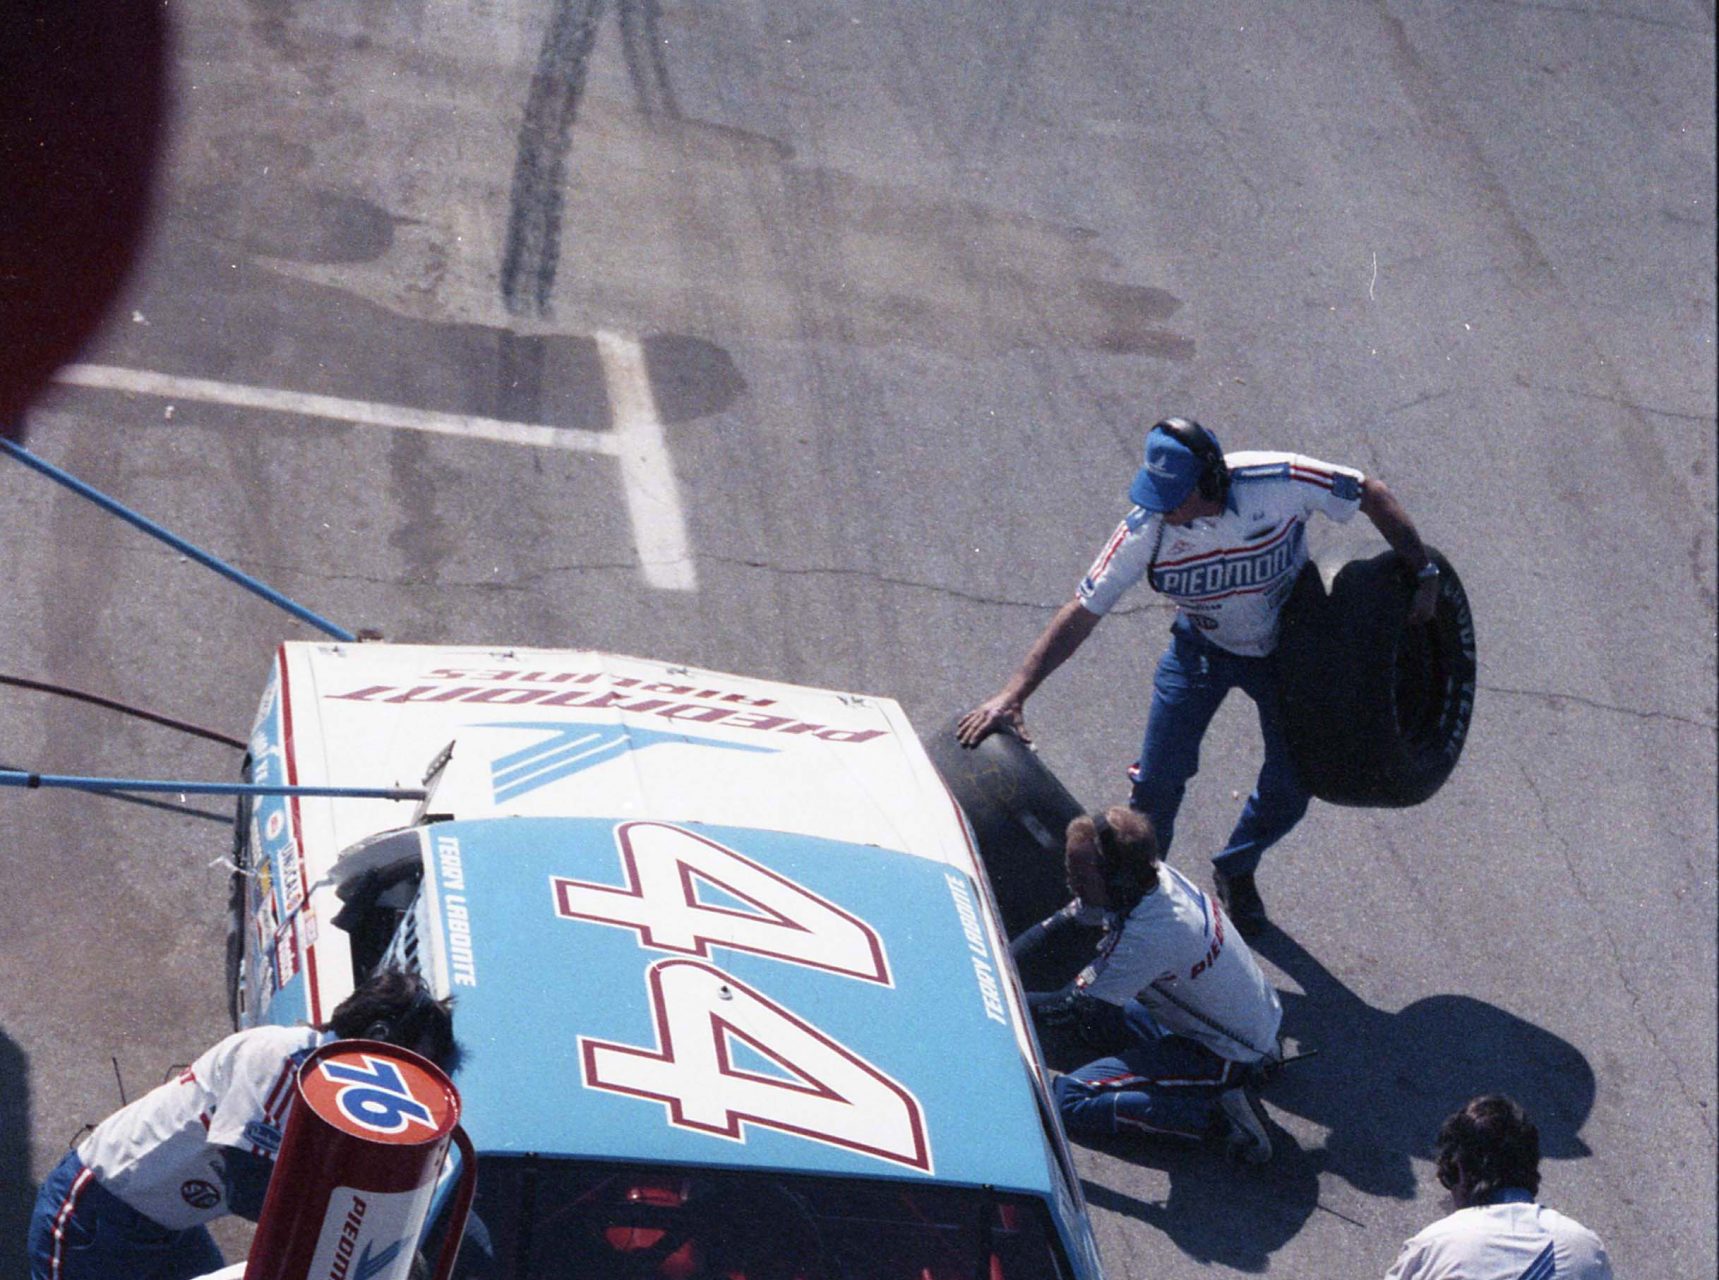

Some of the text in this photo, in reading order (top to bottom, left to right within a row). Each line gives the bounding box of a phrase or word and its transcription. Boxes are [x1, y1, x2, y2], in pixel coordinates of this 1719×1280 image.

[324, 685, 890, 743] PIEDMONT
[420, 667, 779, 706] AIRLINES
[437, 835, 477, 988] TERRY LABONTE
[945, 873, 1006, 1026] TERRY LABONTE
[548, 820, 936, 1176] 44
[319, 1054, 439, 1135] 76
